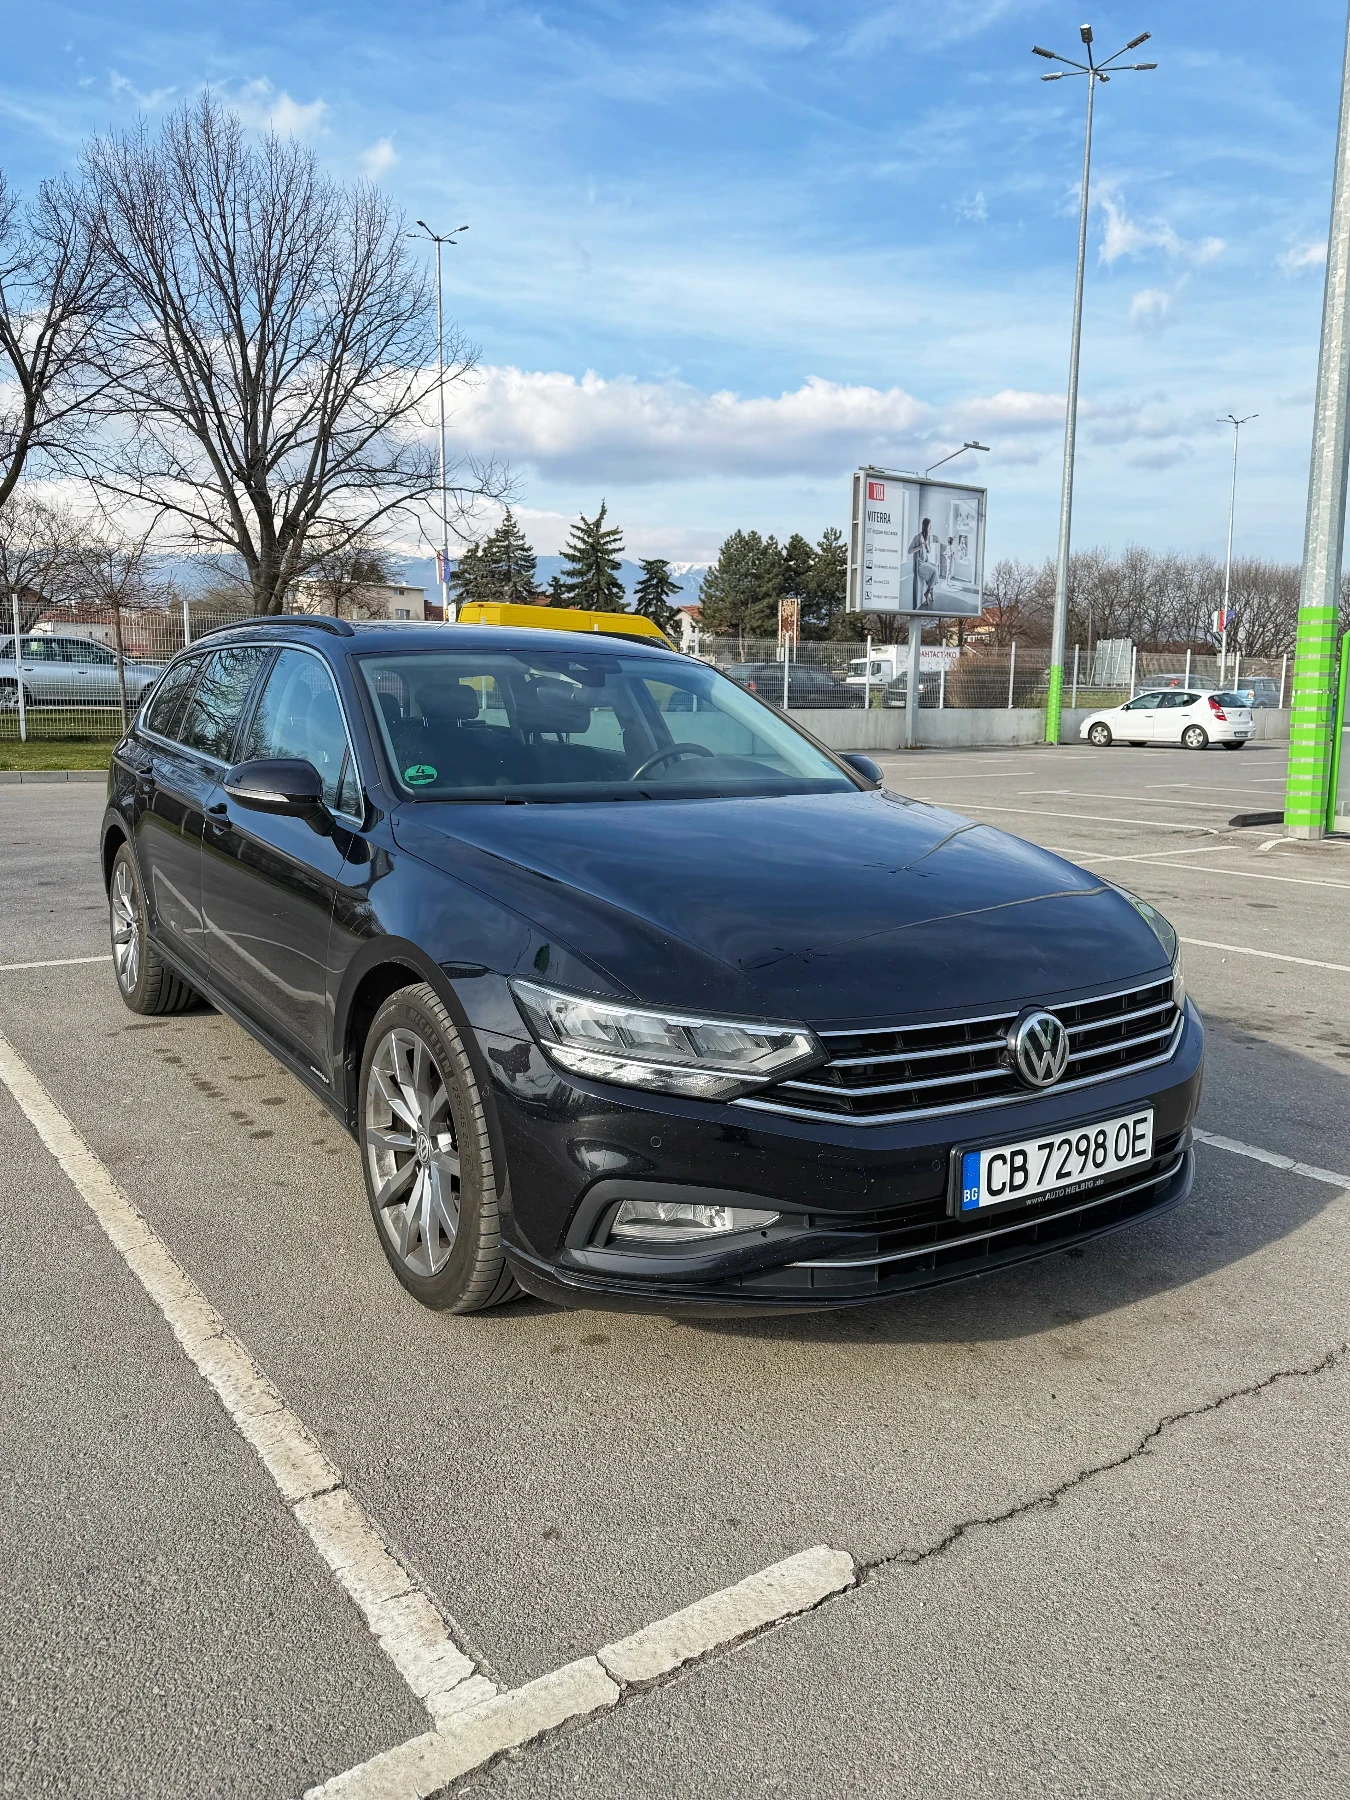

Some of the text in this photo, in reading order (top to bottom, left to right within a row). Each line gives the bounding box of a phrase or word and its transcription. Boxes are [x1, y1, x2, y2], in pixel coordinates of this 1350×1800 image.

[873, 483, 884, 500] VOX
[867, 510, 891, 525] VITERRA
[920, 650, 957, 659] АНТАСТИКО
[415, 765, 427, 775] 4
[407, 1007, 454, 1074] MICHELIN
[1017, 1011, 1069, 1086] VW
[452, 1086, 467, 1130] 235/45
[462, 1132, 470, 1149] ZR
[986, 1116, 1148, 1197] CB 7298 OE
[963, 1187, 979, 1203] BG
[1065, 1180, 1094, 1195] HELBIG
